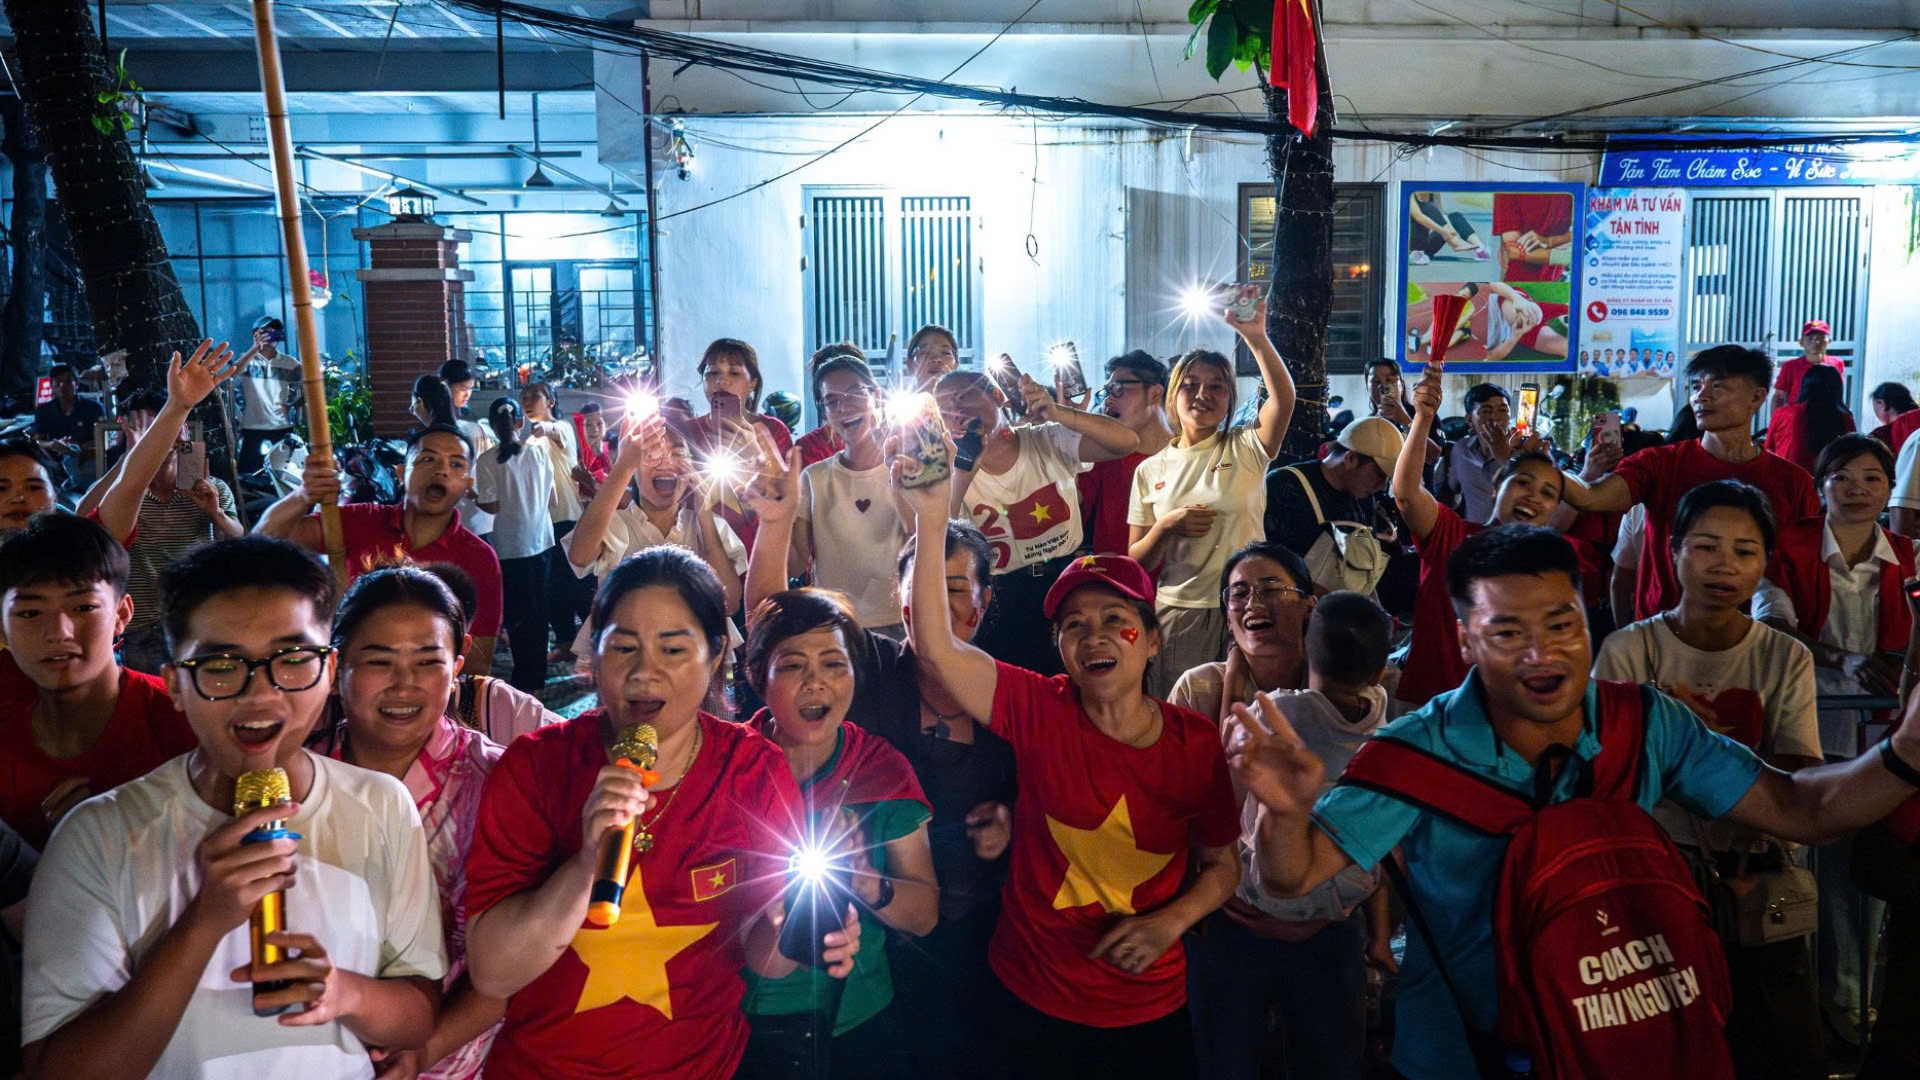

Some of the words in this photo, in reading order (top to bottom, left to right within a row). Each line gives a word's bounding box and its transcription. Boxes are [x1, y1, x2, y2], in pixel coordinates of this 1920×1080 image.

[1590, 193, 1622, 211] KHÁM
[1625, 193, 1639, 211] VÀ
[1642, 195, 1657, 211] TƯ
[1659, 191, 1681, 211] VẤN
[1610, 216, 1632, 238] TẬN
[1635, 217, 1659, 235] TÌNH
[1578, 933, 1675, 985] COACH
[1572, 986, 1628, 1032] THÁI
[1621, 965, 1700, 1022] NGUYÊN
